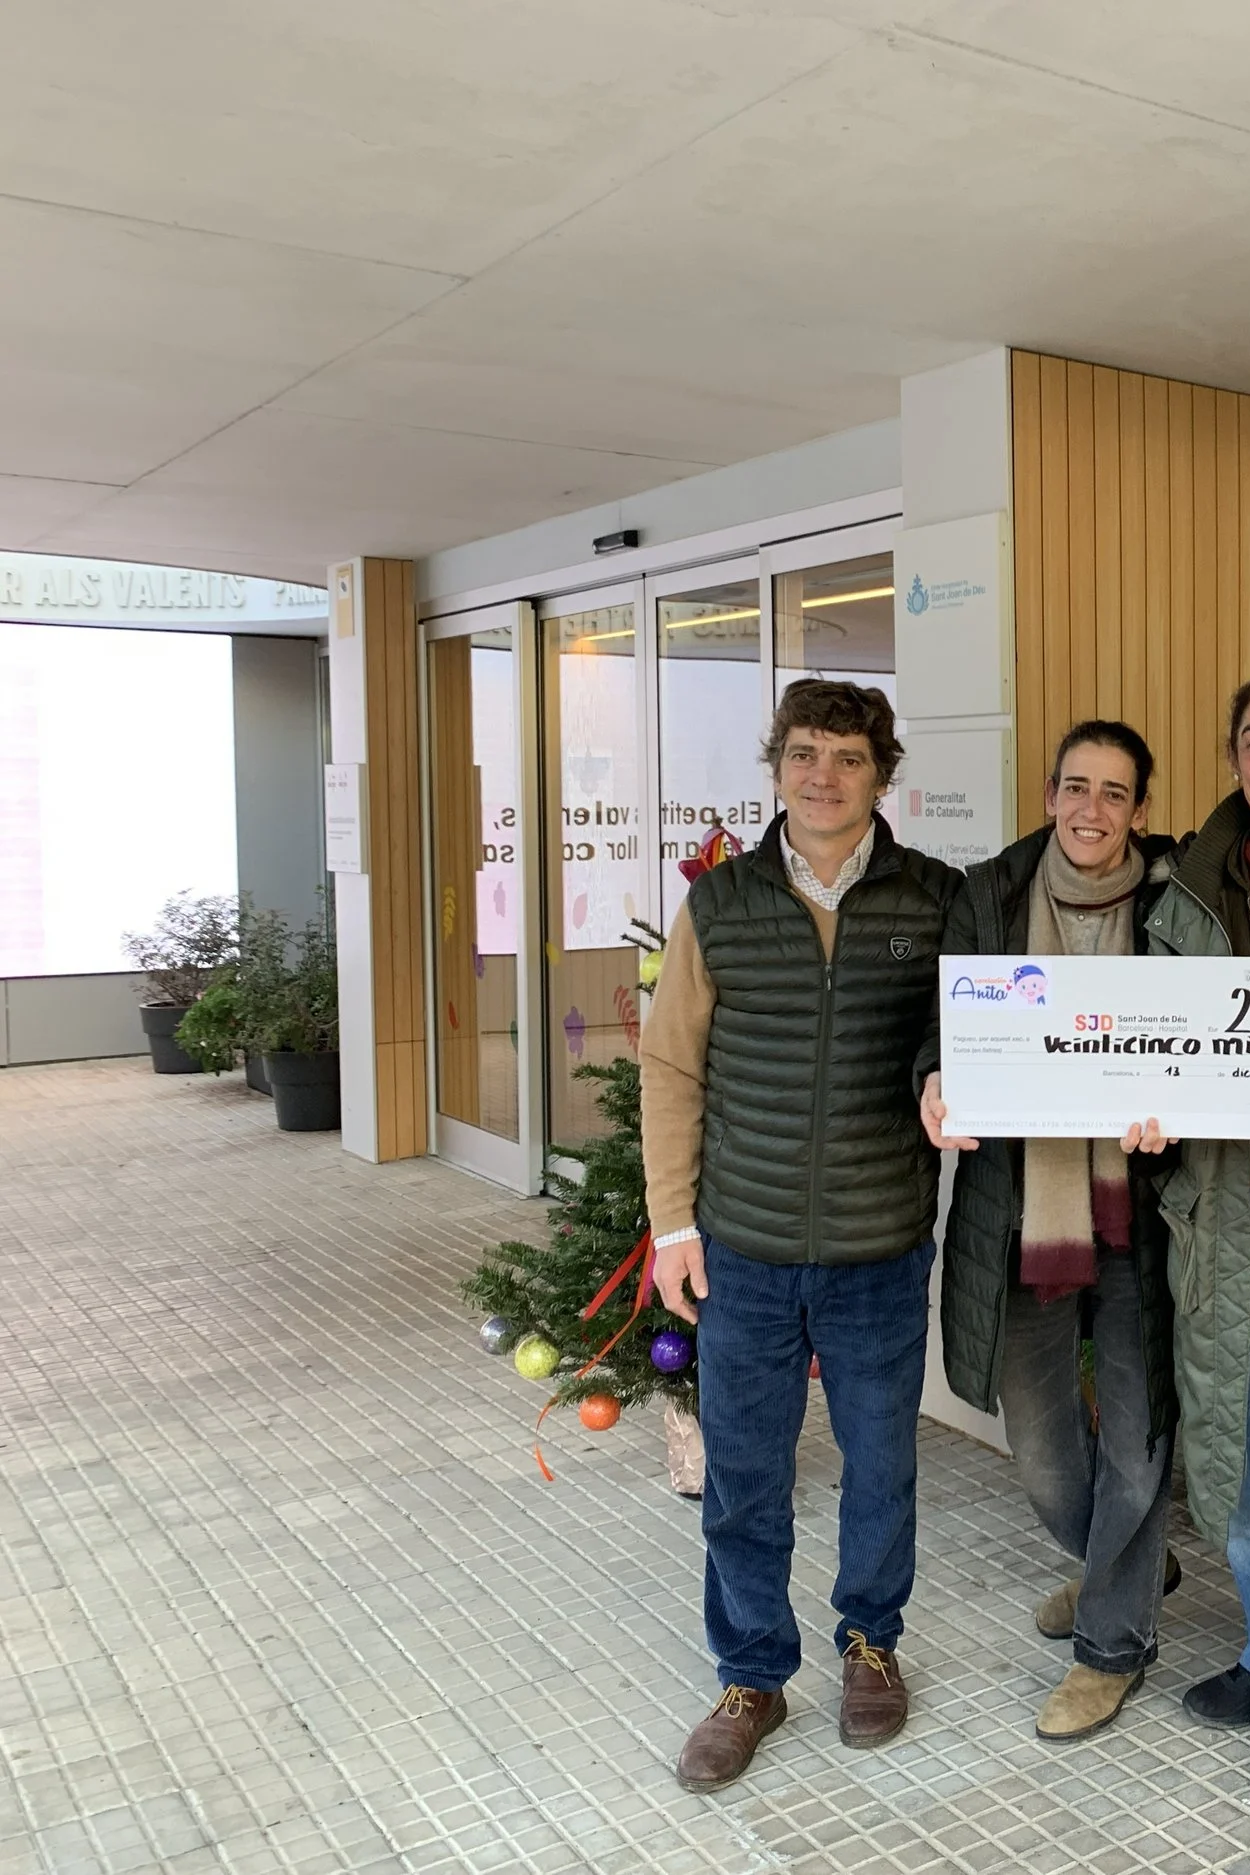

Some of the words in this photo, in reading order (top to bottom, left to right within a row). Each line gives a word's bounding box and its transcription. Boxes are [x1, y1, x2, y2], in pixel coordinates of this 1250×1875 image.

[35, 569, 102, 607] ALS
[112, 570, 246, 609] VALENTS
[925, 792, 966, 803] Generalitat
[925, 806, 934, 817] de
[936, 806, 974, 820] Catalunya
[949, 976, 1008, 1001] Anita
[1075, 1014, 1113, 1031] SJD
[1117, 1015, 1137, 1023] Sant
[1138, 1015, 1158, 1023] Joan
[1160, 1015, 1170, 1024] de
[1172, 1014, 1188, 1024] Déu
[1117, 1024, 1153, 1032] Barcelona
[1159, 1024, 1188, 1033] Hospital
[1165, 1065, 1180, 1077] 13
